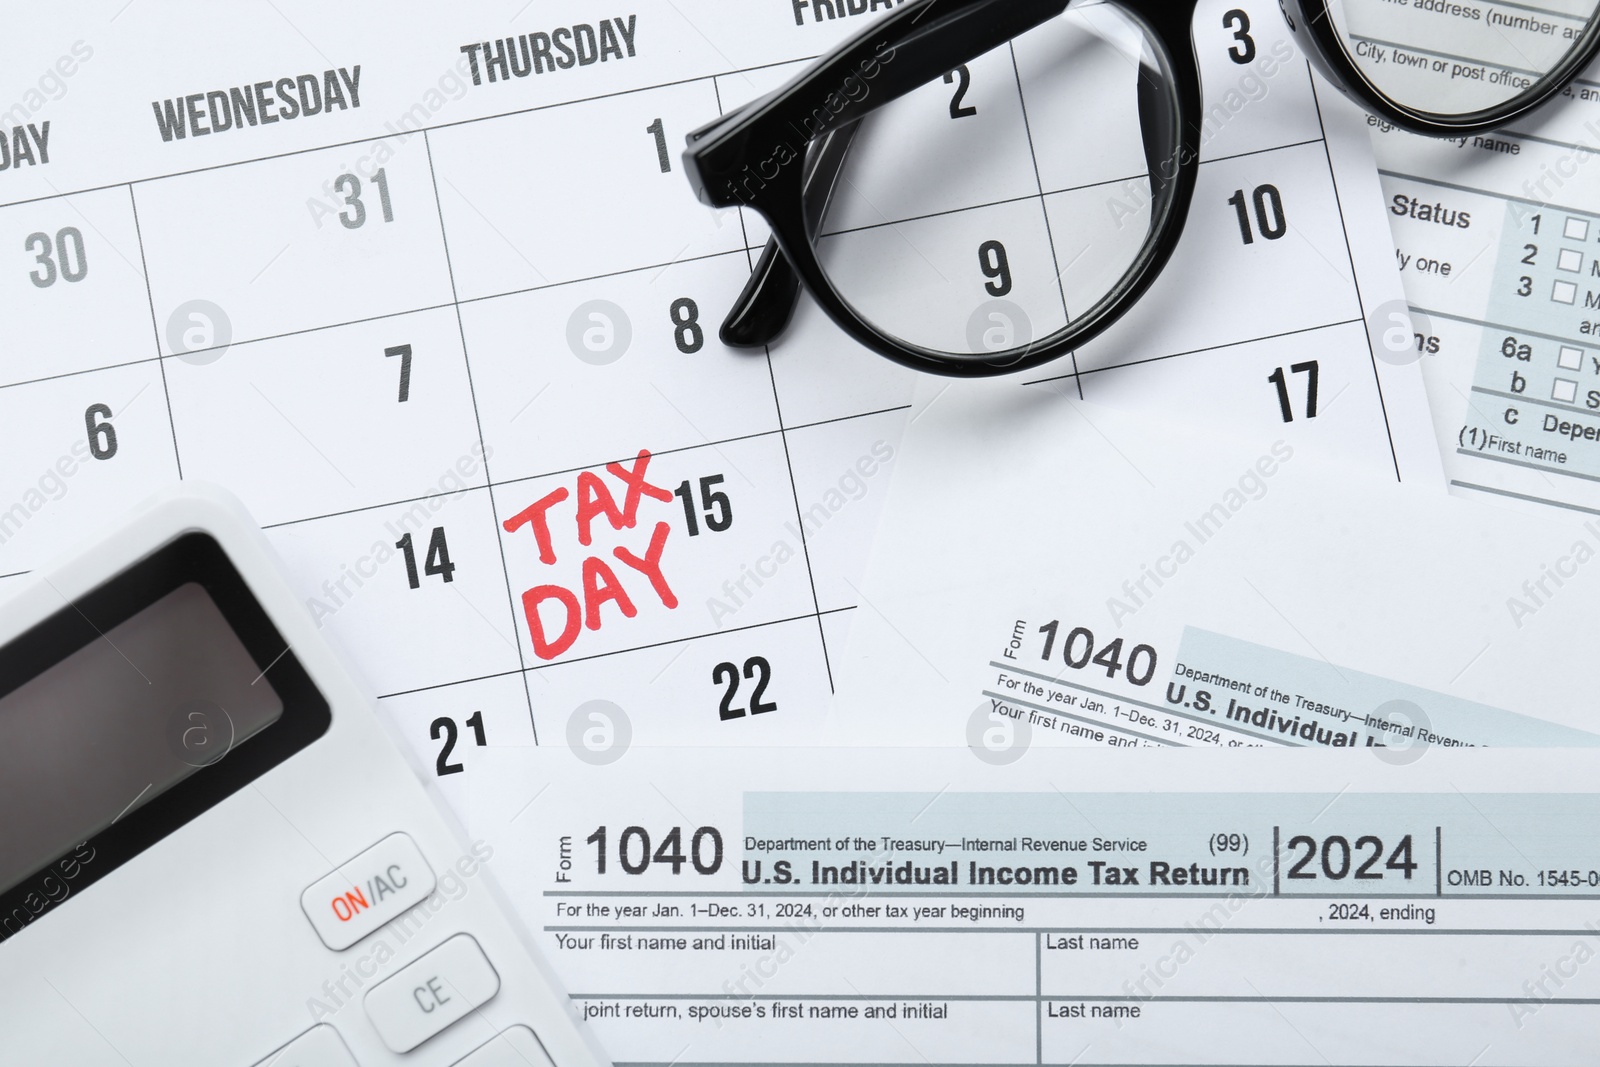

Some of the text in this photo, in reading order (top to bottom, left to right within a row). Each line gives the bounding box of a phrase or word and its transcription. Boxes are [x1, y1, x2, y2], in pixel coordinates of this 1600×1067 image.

[1222, 9, 1256, 65] 3
[1413, 0, 1481, 20] address
[1486, 8, 1558, 36] (number
[460, 15, 637, 85] THURSDAY
[1356, 41, 1386, 62] City,
[1392, 50, 1427, 72] town
[1432, 60, 1448, 72] or
[1451, 63, 1485, 81] post
[152, 64, 361, 142] WEDNESDAY
[943, 64, 977, 119] 2
[646, 118, 671, 173] 1
[1473, 136, 1521, 155] name
[334, 167, 394, 230] 31
[1228, 184, 1286, 245] 10
[1391, 194, 1470, 229] Status
[1531, 215, 1541, 235] 1
[25, 226, 88, 289] 30
[978, 240, 1012, 297] 9
[1416, 257, 1451, 276] one
[1521, 243, 1538, 265] 2
[1517, 276, 1533, 297] 3
[671, 297, 704, 354] 8
[1501, 336, 1532, 362] 6a
[384, 344, 412, 403] 7
[1268, 360, 1318, 423] 17
[1511, 371, 1526, 393] b
[85, 403, 118, 460] 6
[1504, 408, 1519, 425] c
[1525, 446, 1567, 464] name
[503, 449, 673, 564] TAX
[674, 474, 733, 536] 15
[396, 526, 455, 589] 14
[521, 521, 678, 660] DAY
[1004, 619, 1157, 686] Form 1040
[712, 655, 777, 721] 22
[1175, 663, 1252, 694] Department
[1254, 685, 1268, 698] of
[1270, 688, 1291, 704] the
[990, 699, 1025, 719] Your
[1029, 709, 1057, 729] first
[1061, 722, 1104, 741] name
[998, 674, 1020, 690] For
[1023, 679, 1044, 697] the
[1047, 689, 1077, 705] year
[1080, 698, 1106, 715] Jan.
[1163, 719, 1182, 736] 31,
[1187, 726, 1222, 747] 2024,
[1167, 682, 1357, 747] U.S. Individual
[430, 710, 487, 777] 21
[555, 826, 723, 883] Form 1040
[745, 837, 829, 853] Department
[831, 837, 850, 850] of
[853, 837, 877, 850] the
[1021, 838, 1087, 851] Revenue
[1092, 838, 1148, 851] Service
[1209, 833, 1249, 856] (99)
[1287, 835, 1417, 880] 2024
[331, 864, 408, 922] ON/AC
[742, 860, 1250, 885] U.S. Individual Income Tax Return
[1447, 870, 1600, 887] OMB No. 1545-0
[556, 904, 582, 917] For
[586, 904, 610, 917] the
[615, 906, 647, 922] year
[652, 904, 684, 918] Jan.
[747, 904, 770, 920] 31,
[775, 904, 818, 920] 2024,
[823, 908, 839, 918] or
[842, 904, 882, 918] other
[886, 905, 908, 918] tax
[914, 907, 946, 922] year
[951, 904, 1024, 922] beginning
[1329, 905, 1374, 922] 2024,
[1380, 904, 1435, 923] ending
[555, 934, 776, 949] Your first name and initial
[1046, 934, 1139, 950] Last name
[413, 977, 451, 1014] CE
[584, 1001, 621, 1021] joint
[625, 1003, 683, 1020] return,
[772, 1002, 804, 1018] first
[809, 1006, 858, 1018] name
[864, 1002, 897, 1018] and
[902, 1002, 947, 1018] initial
[1048, 1002, 1140, 1018] Last name
